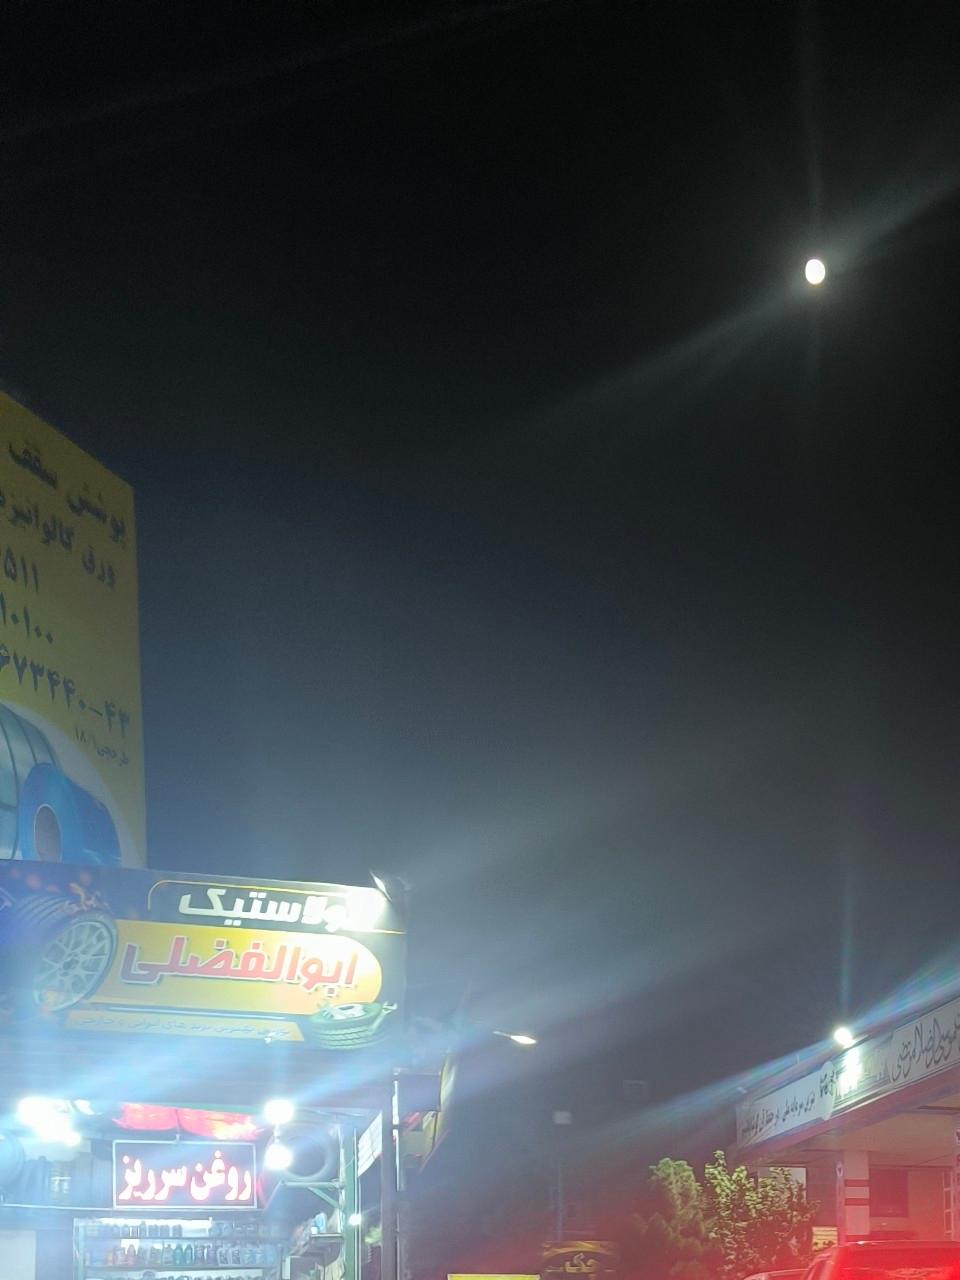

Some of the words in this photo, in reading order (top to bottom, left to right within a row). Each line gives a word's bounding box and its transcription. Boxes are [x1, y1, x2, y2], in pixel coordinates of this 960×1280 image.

[8, 438, 58, 489] سقف
[0, 546, 39, 594] ۵۱۱
[179, 888, 328, 927] لاستیک
[121, 936, 359, 997] ابوالفضلی
[118, 1154, 188, 1200] سرریز
[191, 1149, 252, 1200] روغن
